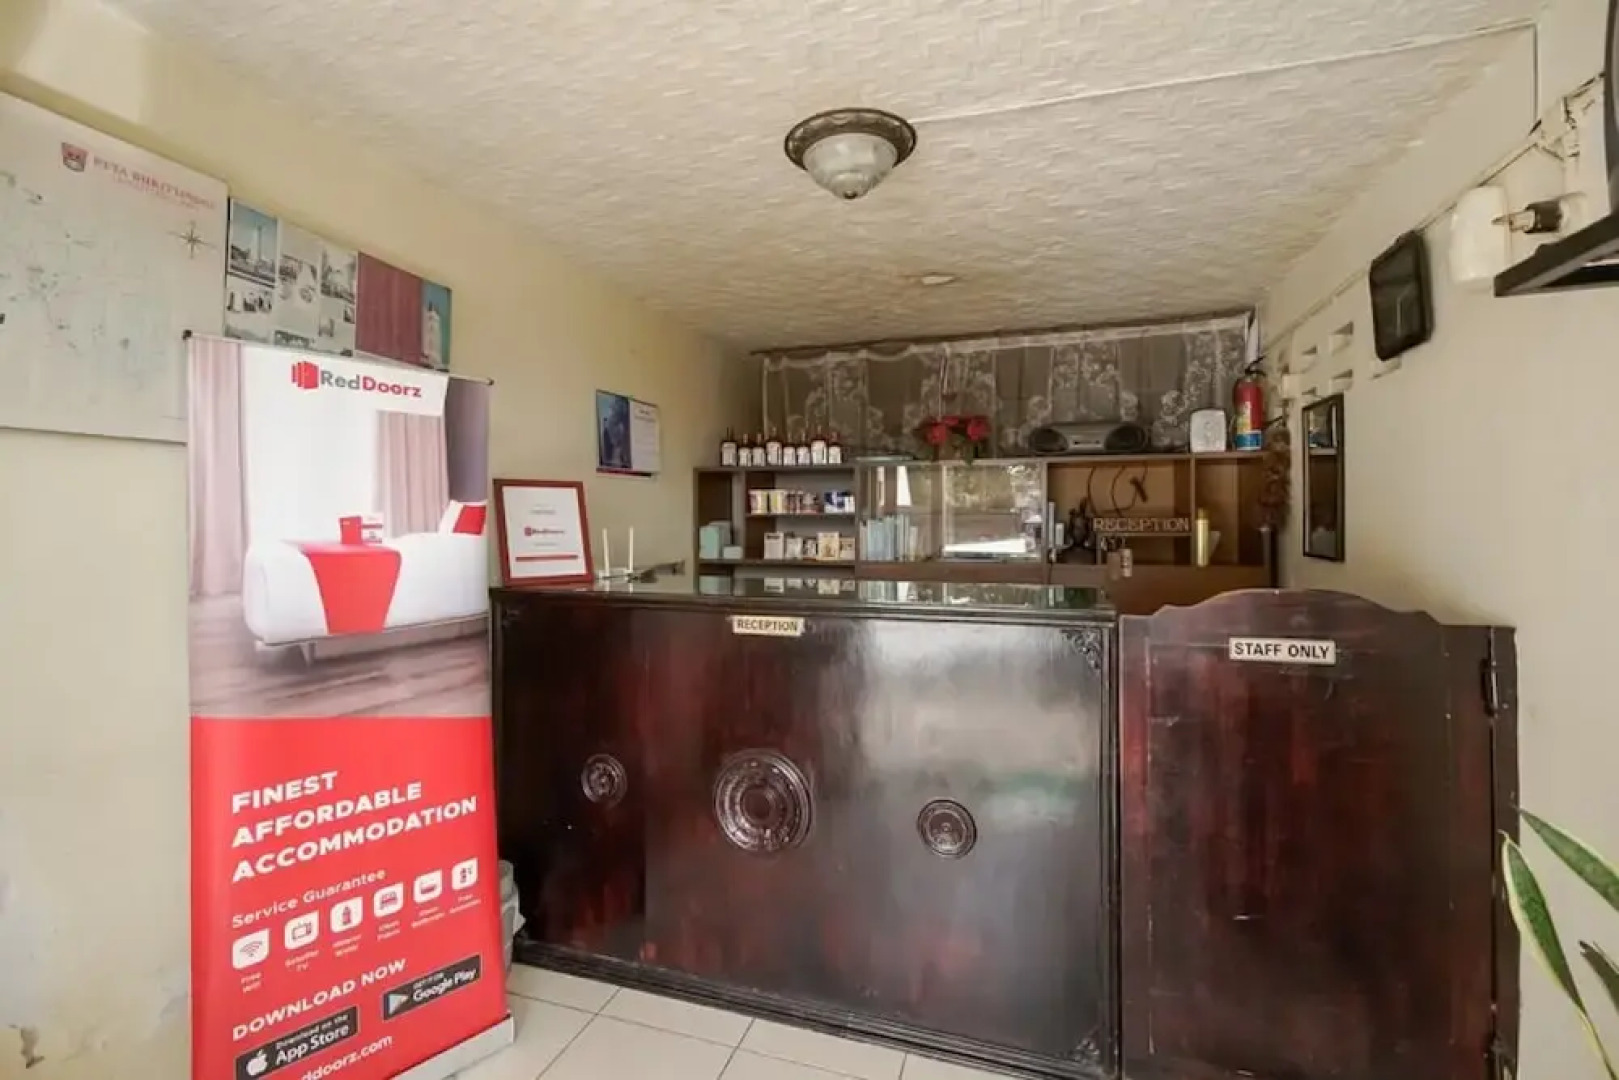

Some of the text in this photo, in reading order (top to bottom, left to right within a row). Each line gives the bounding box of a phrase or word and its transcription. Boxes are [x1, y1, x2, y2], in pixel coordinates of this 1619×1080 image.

[320, 370, 422, 398] RedDoorz
[1093, 517, 1189, 532] RECEPTION
[736, 619, 798, 632] RECEPTION
[1234, 642, 1330, 660] STAFF ONLY
[232, 771, 338, 814] FINEST
[232, 782, 422, 848] AFFORDABLE
[232, 796, 477, 883] ACCOMMODATION
[232, 869, 386, 929] Service Guarantee
[232, 958, 406, 1041] DOWNLOAD NOW
[412, 967, 477, 1003] Google Play
[276, 1023, 349, 1065] App Store
